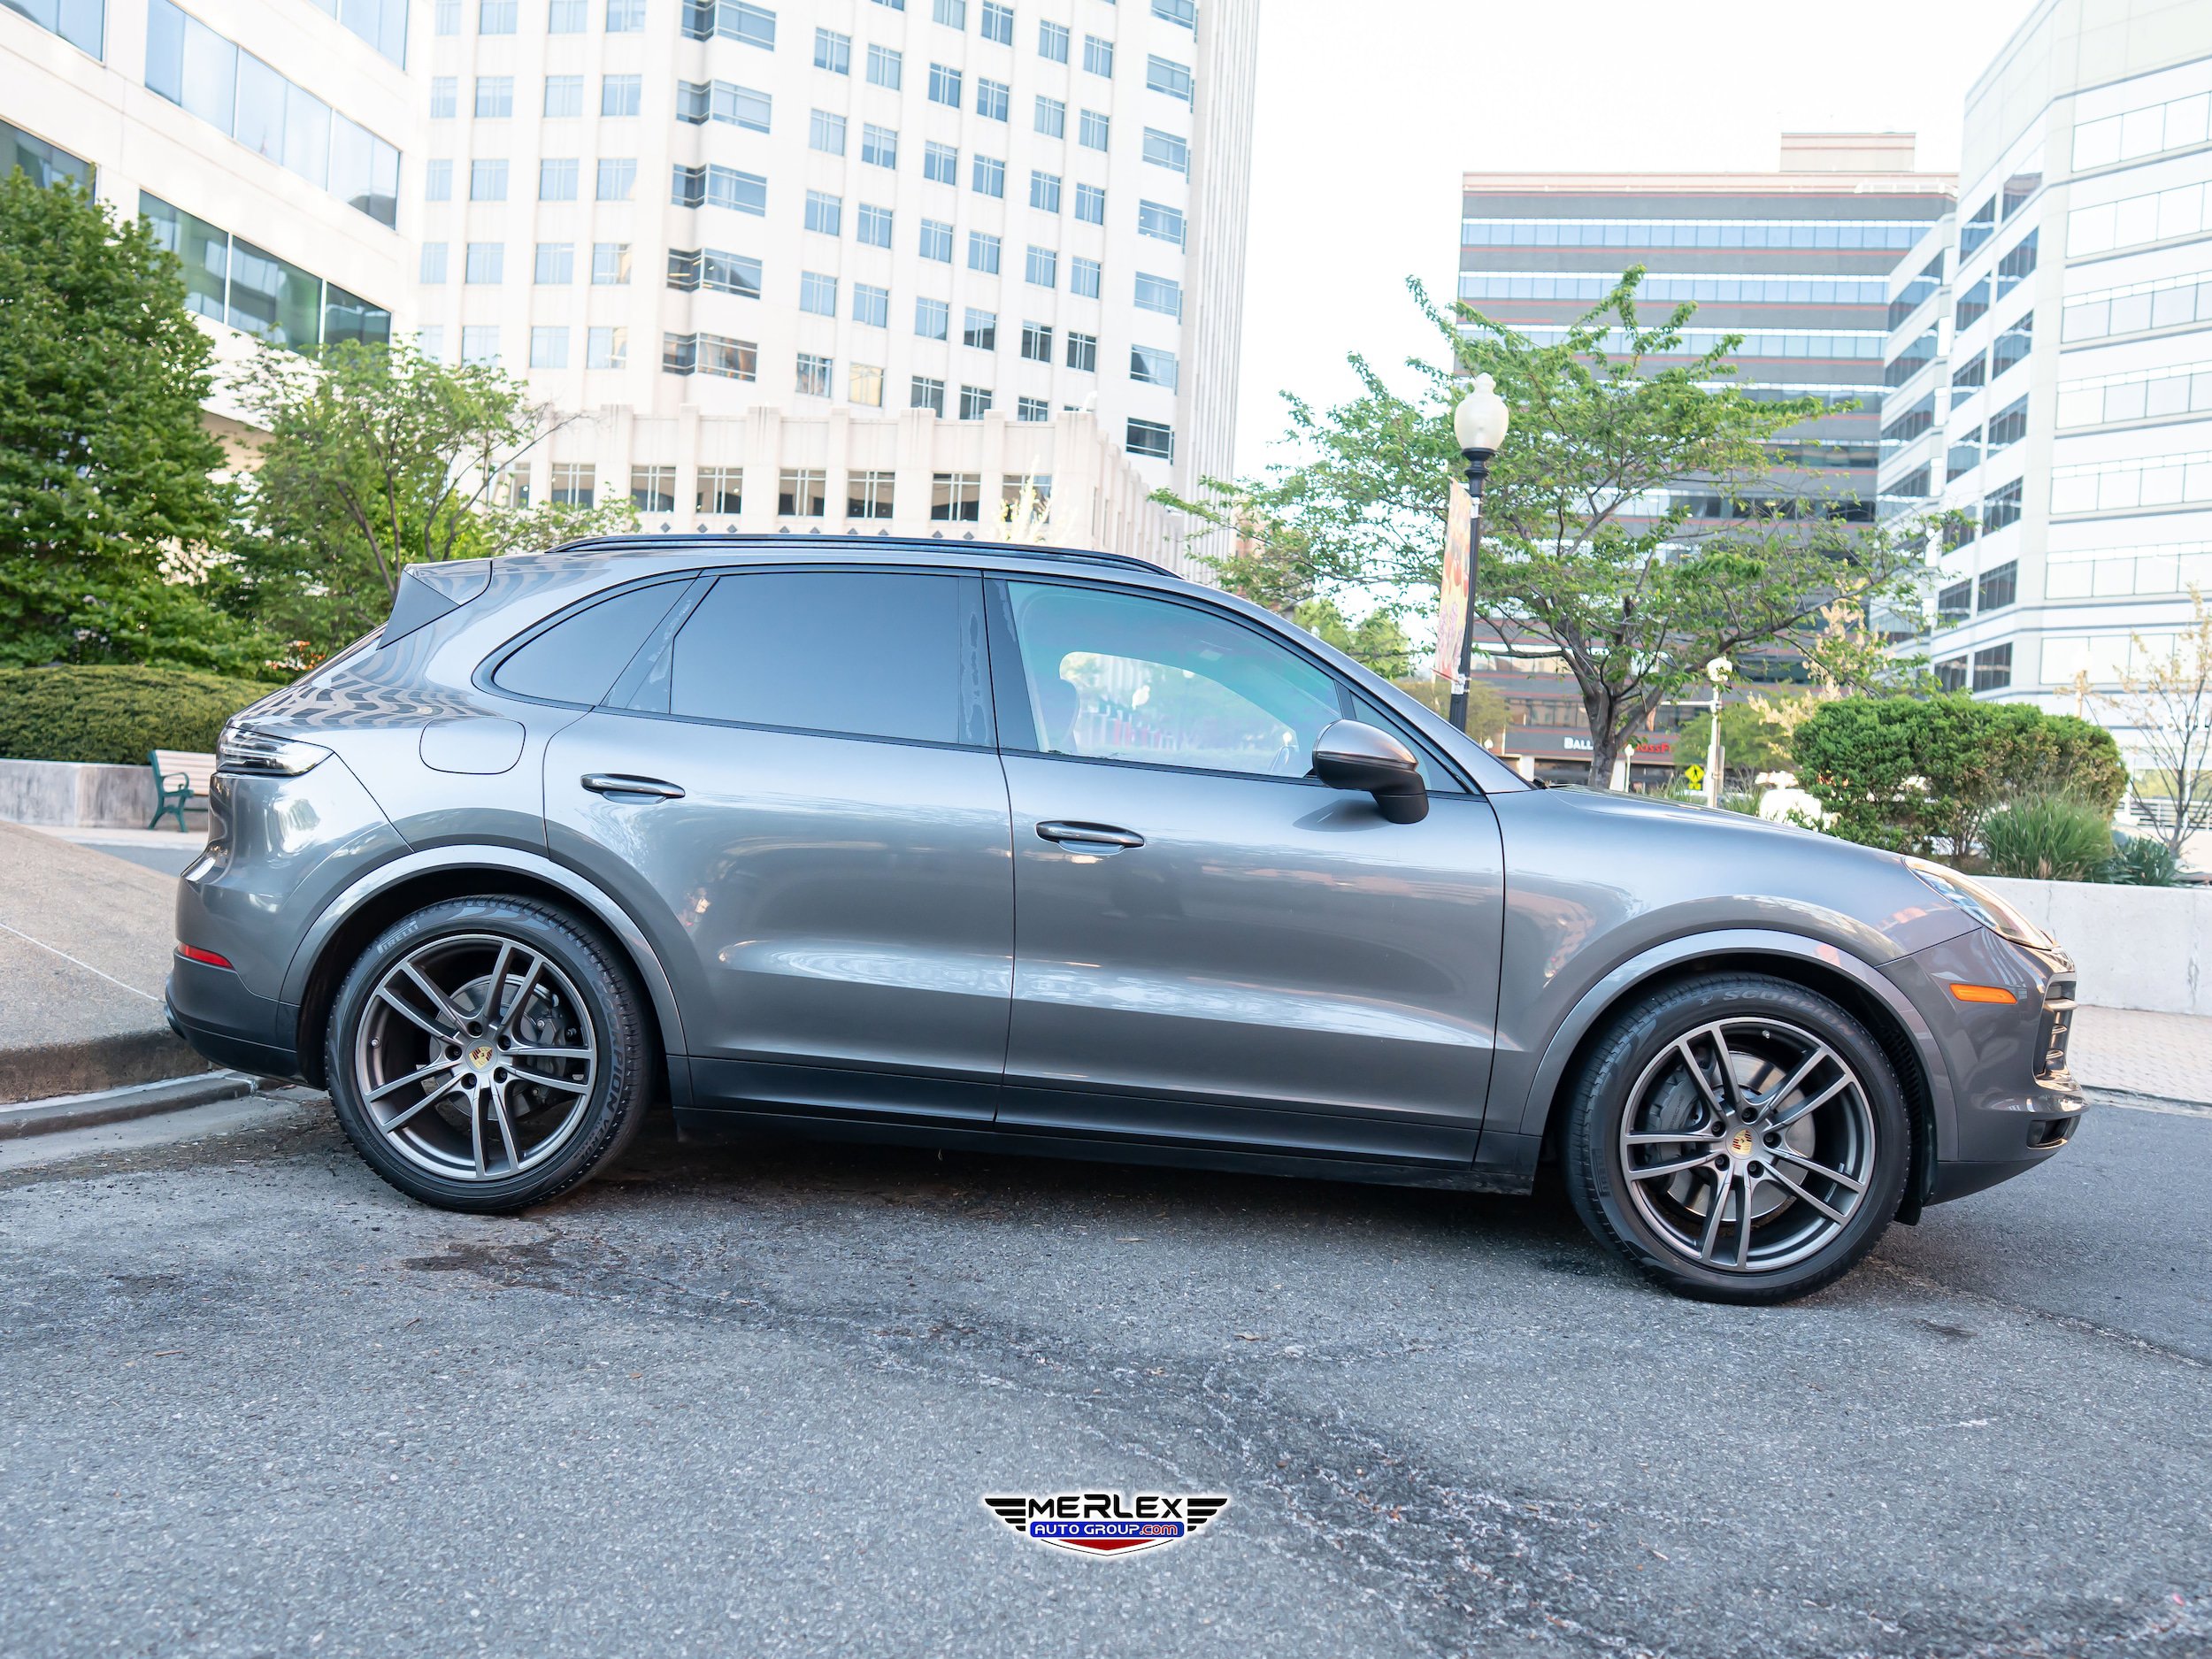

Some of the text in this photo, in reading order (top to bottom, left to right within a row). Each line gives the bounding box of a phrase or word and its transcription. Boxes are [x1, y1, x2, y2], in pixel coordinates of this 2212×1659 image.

[1563, 736, 1594, 750] BALL
[376, 920, 419, 955] PIRELLI
[1723, 989, 1855, 1037] SCORPION
[592, 979, 624, 1112] SCORPION
